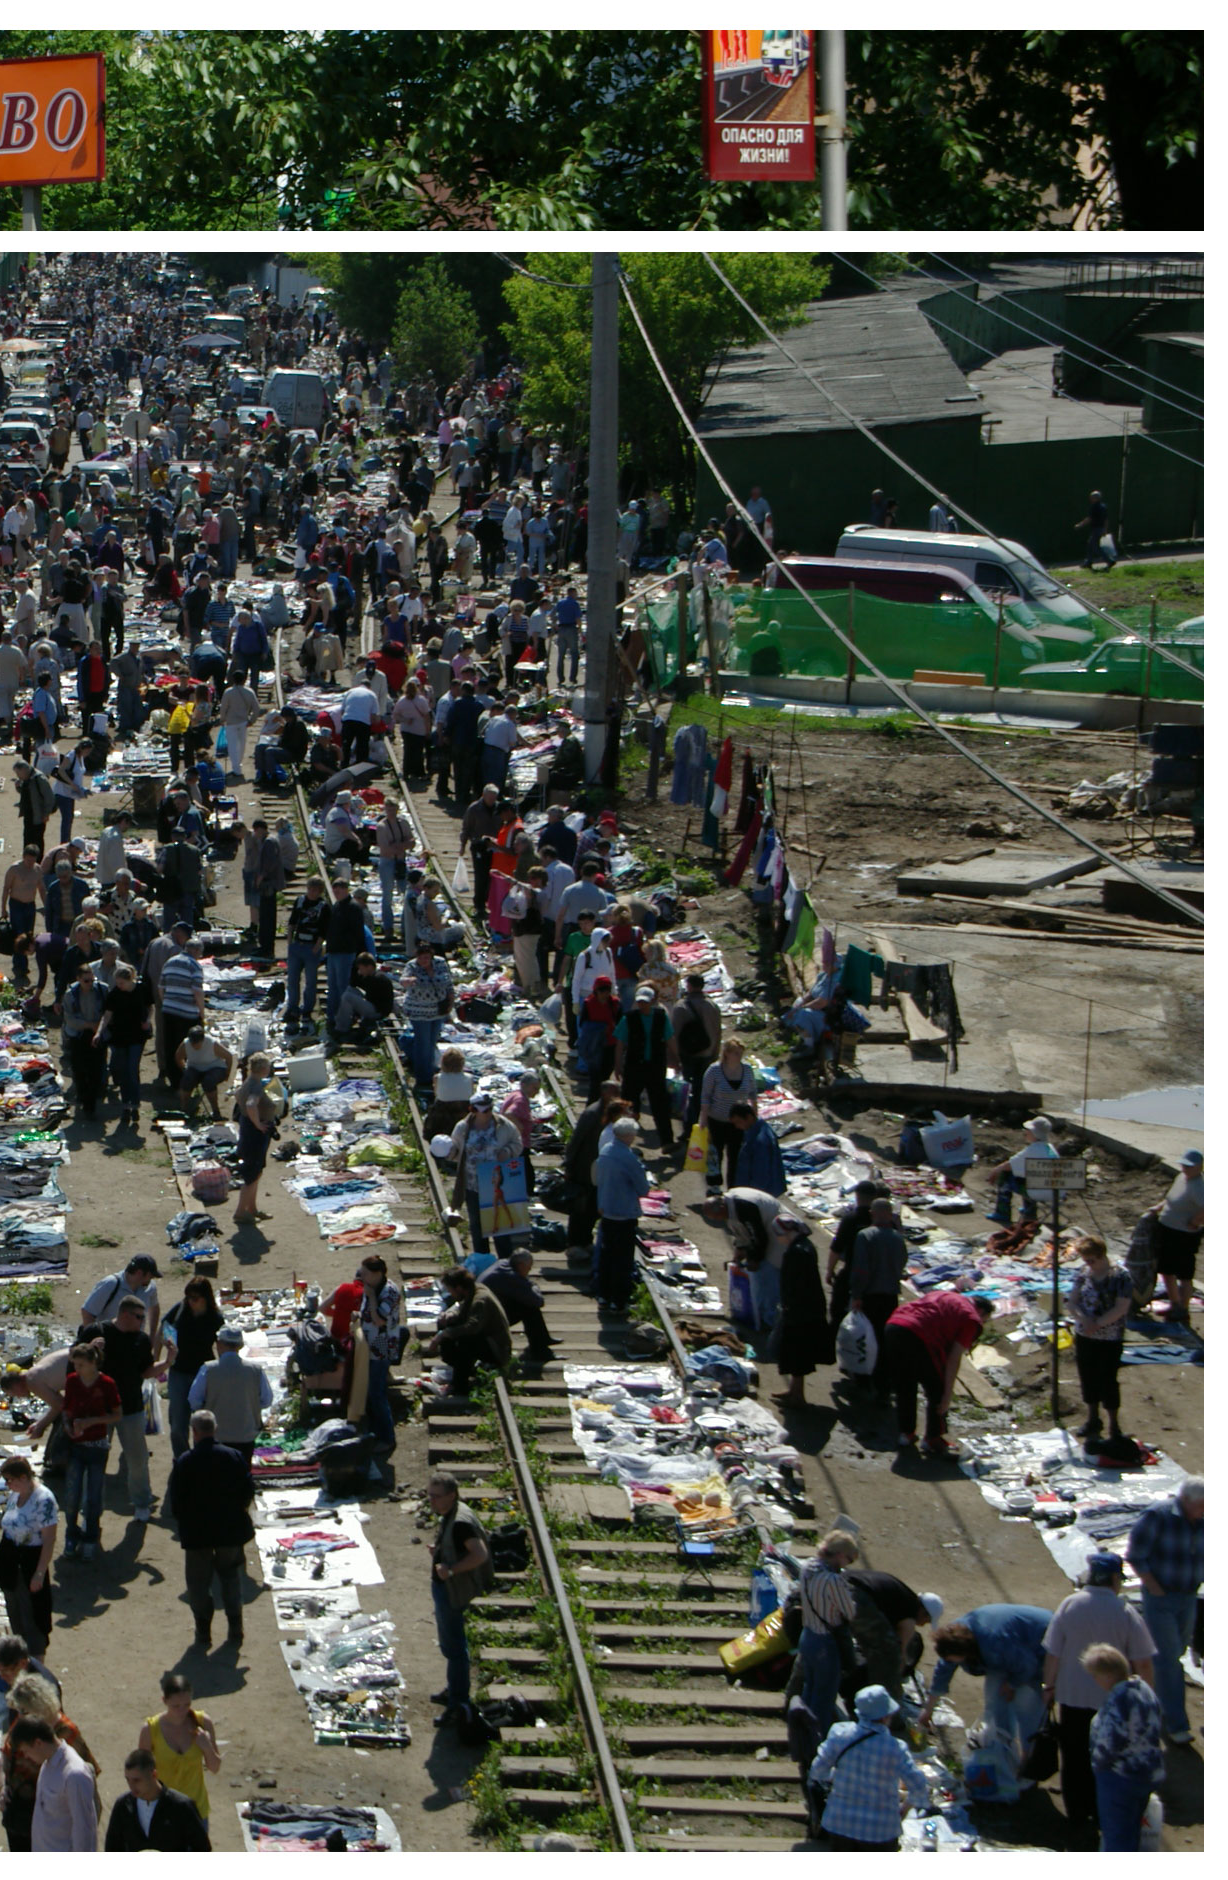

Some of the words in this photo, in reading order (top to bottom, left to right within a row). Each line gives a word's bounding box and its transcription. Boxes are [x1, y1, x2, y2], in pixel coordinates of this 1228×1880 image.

[722, 128, 775, 143] ОПАСНО
[777, 128, 804, 145] ДЛЯ
[739, 148, 790, 163] ЖИЗНИ!
